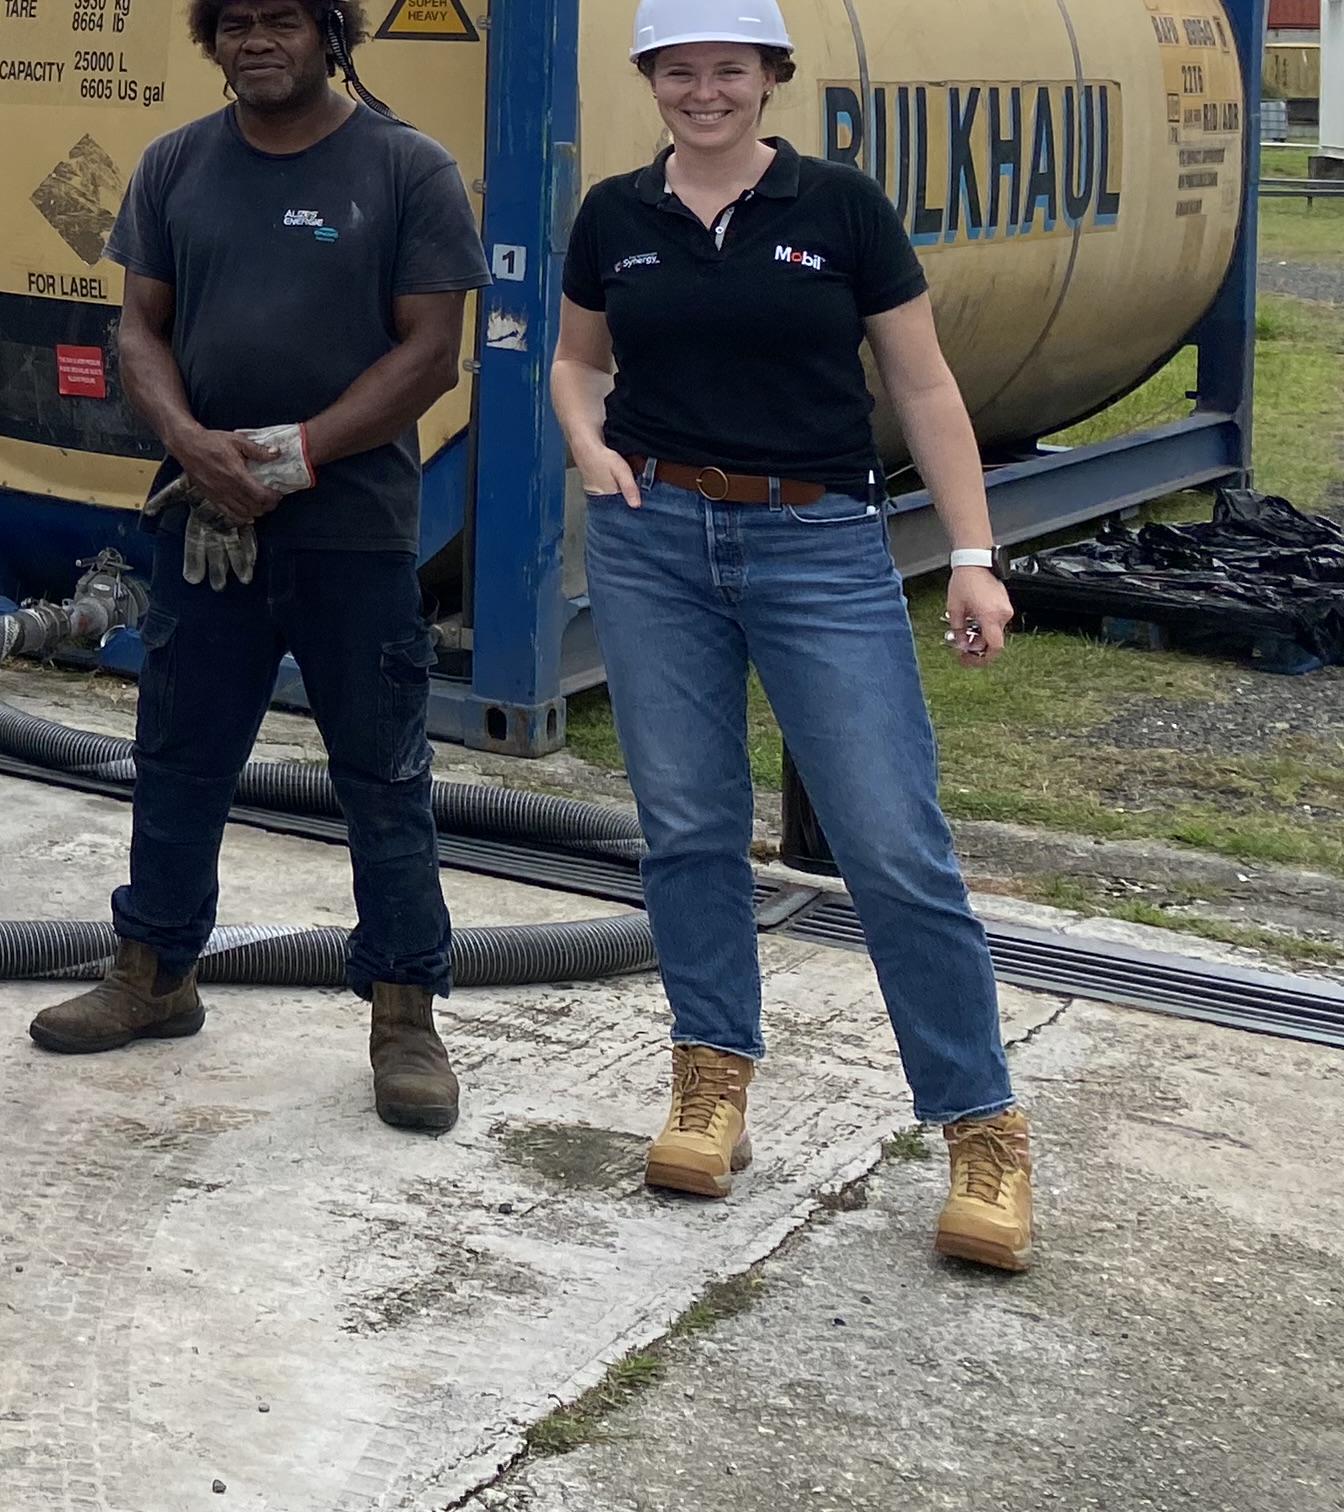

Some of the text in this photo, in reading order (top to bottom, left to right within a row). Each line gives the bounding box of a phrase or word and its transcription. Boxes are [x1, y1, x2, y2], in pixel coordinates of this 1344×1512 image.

[72, 12, 125, 33] 8664 lb
[407, 11, 448, 21] HEAVY
[0, 51, 127, 82] CAPACITY 25000 L
[81, 78, 165, 107] 6605 US gal
[502, 250, 515, 274] 1
[774, 245, 821, 270] Mobil
[28, 272, 107, 299] FOR LABEL
